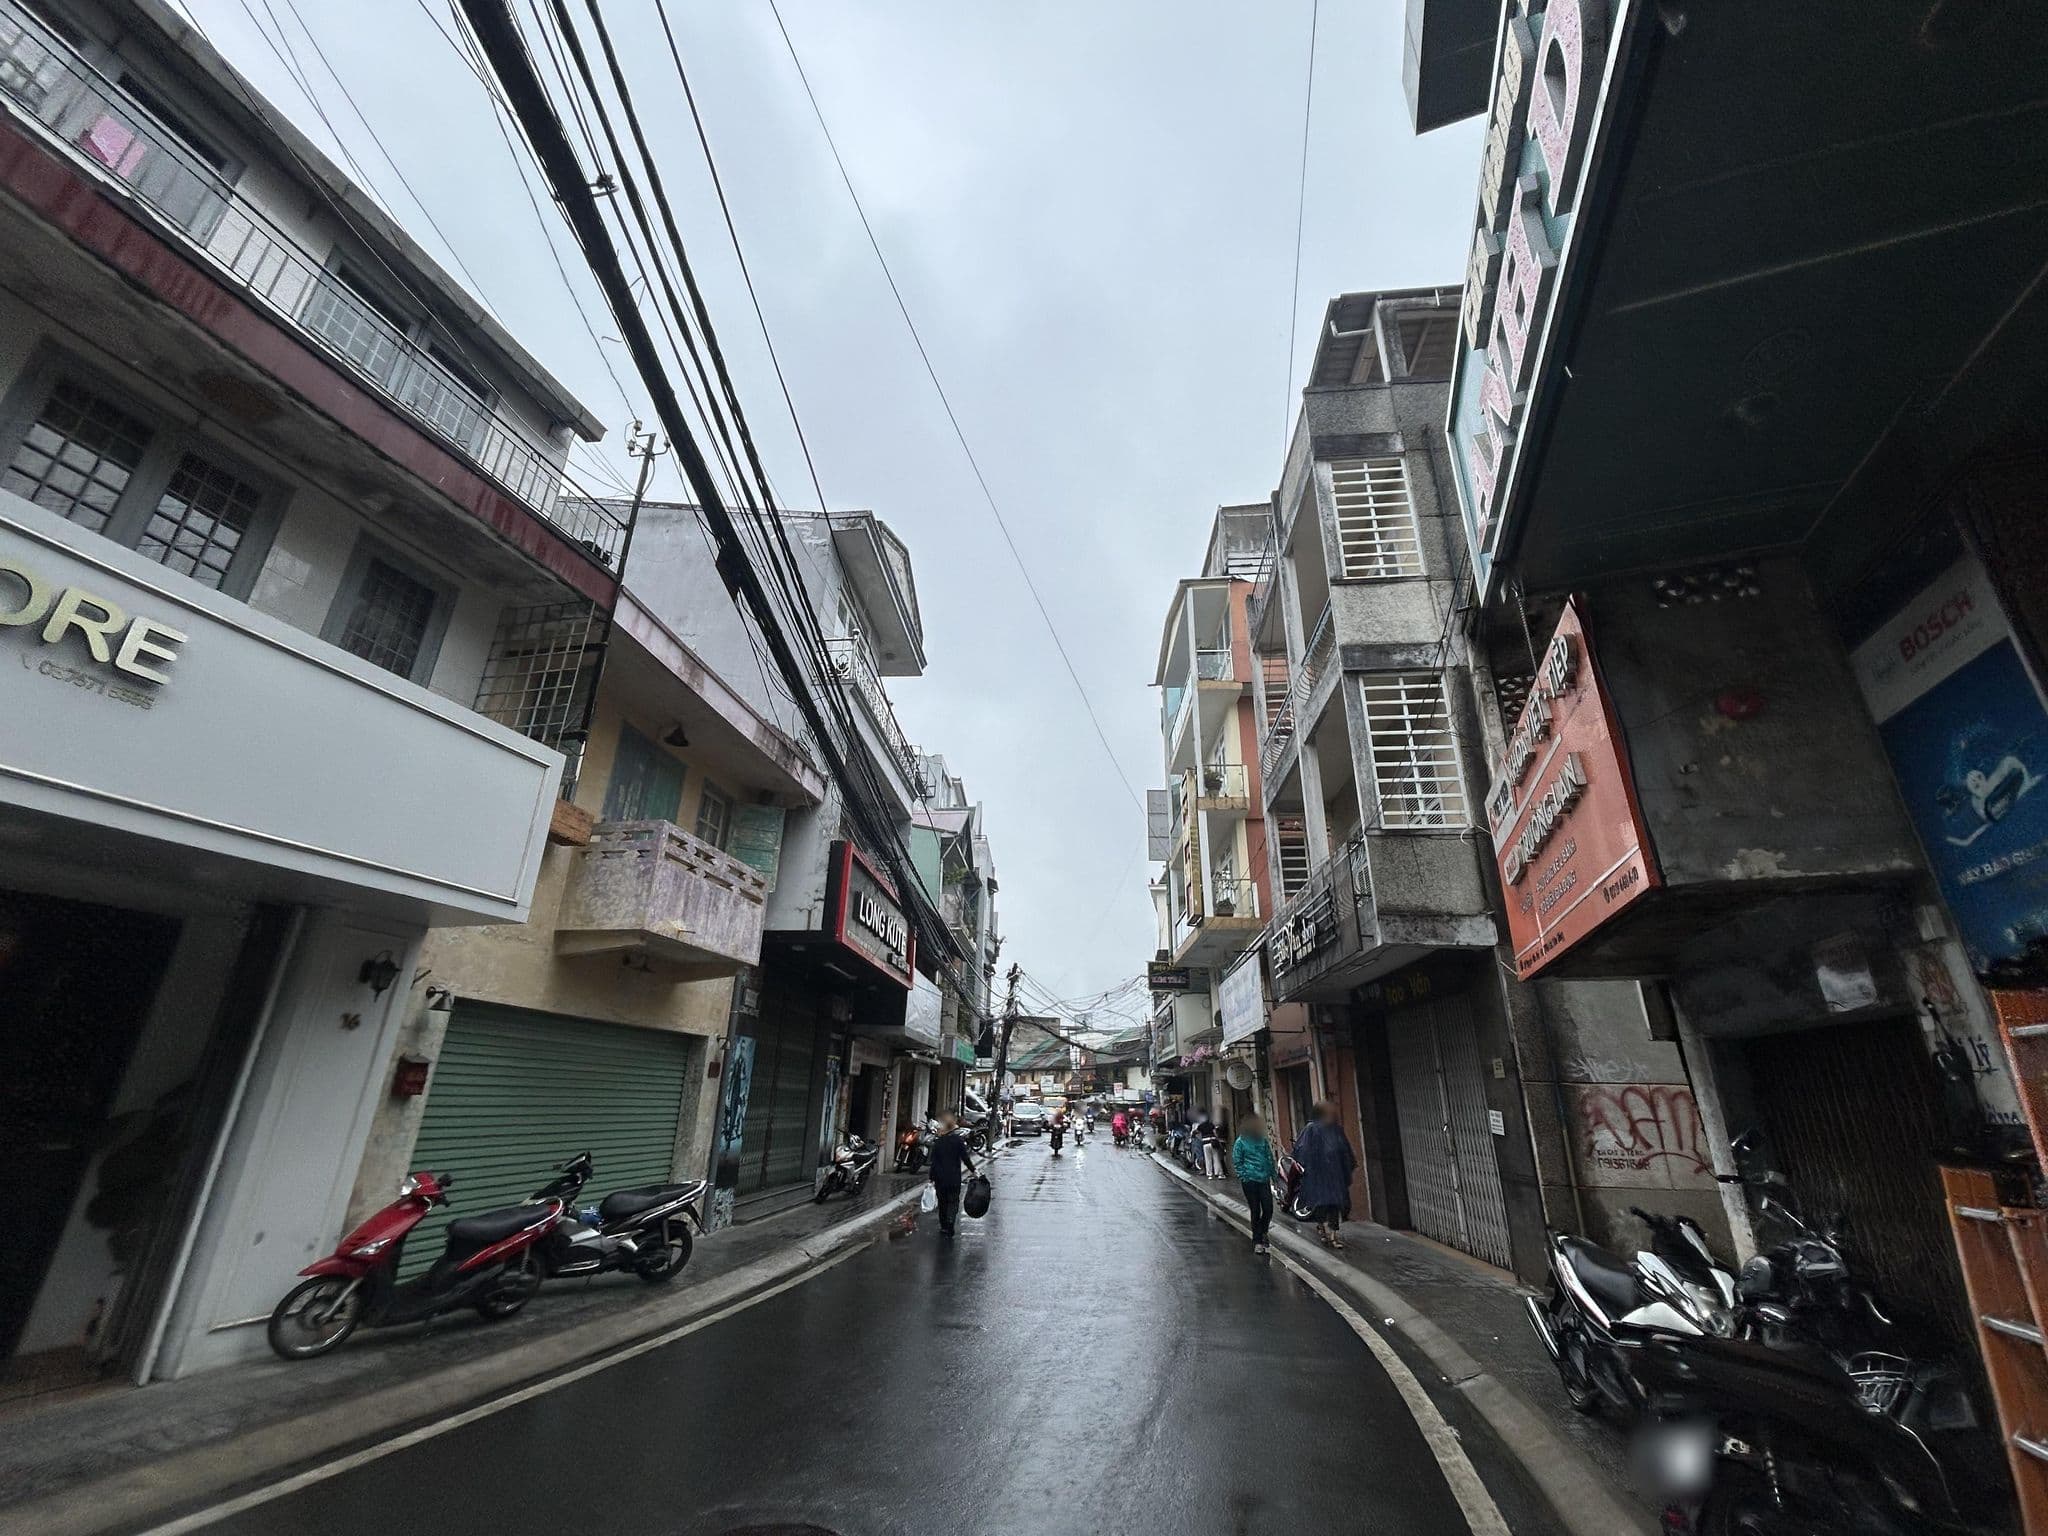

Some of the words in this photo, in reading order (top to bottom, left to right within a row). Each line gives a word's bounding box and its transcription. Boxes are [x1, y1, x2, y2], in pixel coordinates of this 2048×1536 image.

[1471, 176, 1543, 551] ANH
[1899, 588, 1976, 663] BOSCH
[1550, 752, 1580, 815] LAN
[859, 891, 886, 938] LONG
[886, 916, 907, 956] KUTE
